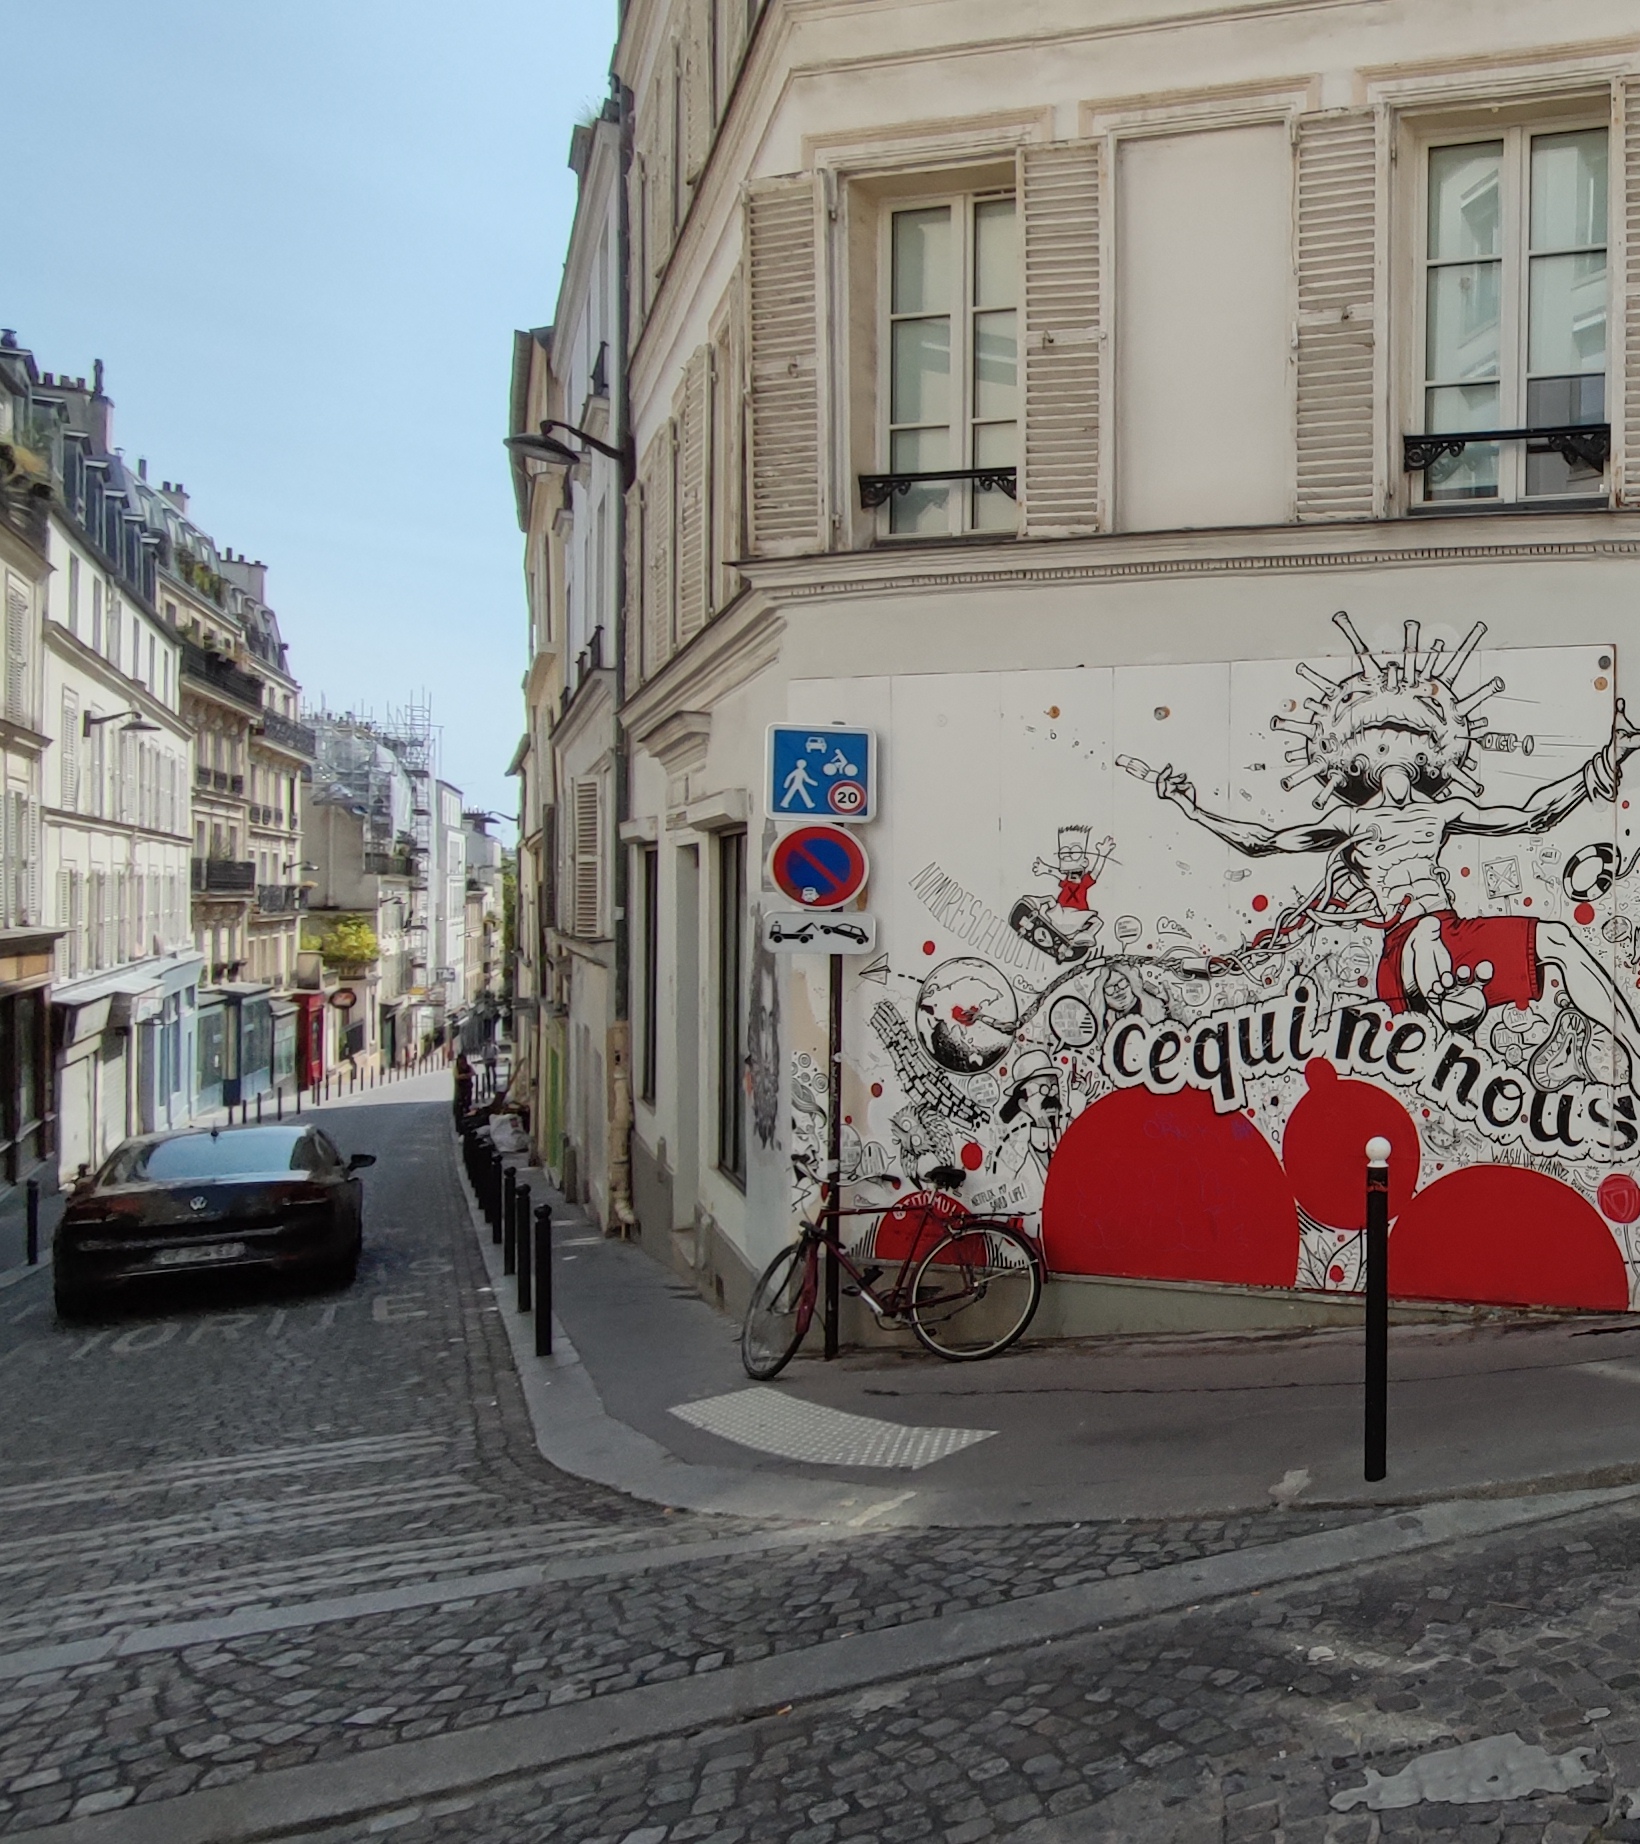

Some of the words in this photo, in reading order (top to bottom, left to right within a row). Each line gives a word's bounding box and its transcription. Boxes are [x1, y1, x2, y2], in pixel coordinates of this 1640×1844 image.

[837, 791, 858, 804] 20
[1491, 1144, 1522, 1167] WASH
[971, 1190, 996, 1207] NETFLIX
